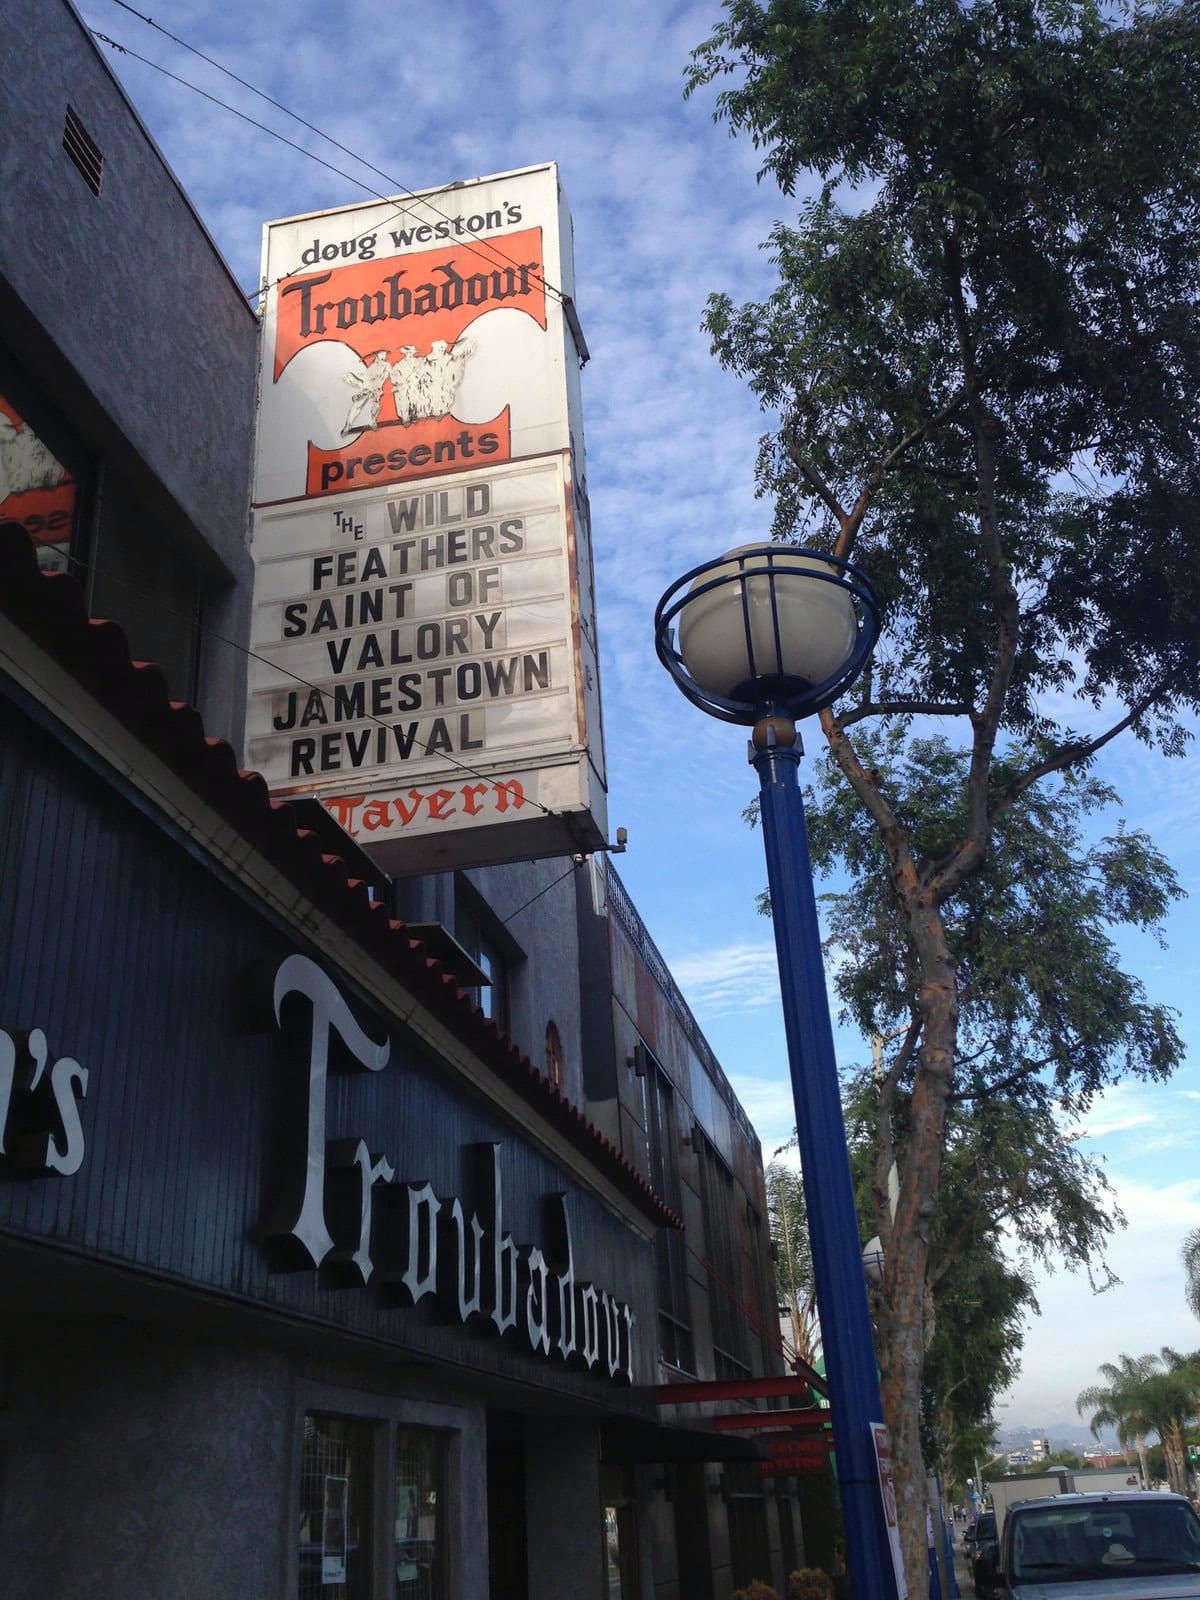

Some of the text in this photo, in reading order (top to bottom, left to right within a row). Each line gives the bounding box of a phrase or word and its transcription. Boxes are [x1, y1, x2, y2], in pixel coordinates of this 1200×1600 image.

[301, 201, 522, 266] doug weston's
[282, 260, 540, 338] Troubadour
[321, 430, 499, 490] presents
[333, 483, 490, 541] THE WILD
[312, 519, 523, 591] FEATHERS
[283, 567, 499, 638] SAINT OF
[327, 612, 502, 674] VALORY
[273, 652, 549, 730] JAMESTOWN
[290, 714, 483, 777] REVIVAL
[324, 777, 525, 837] Tavern
[274, 954, 636, 1385] Troubadour
